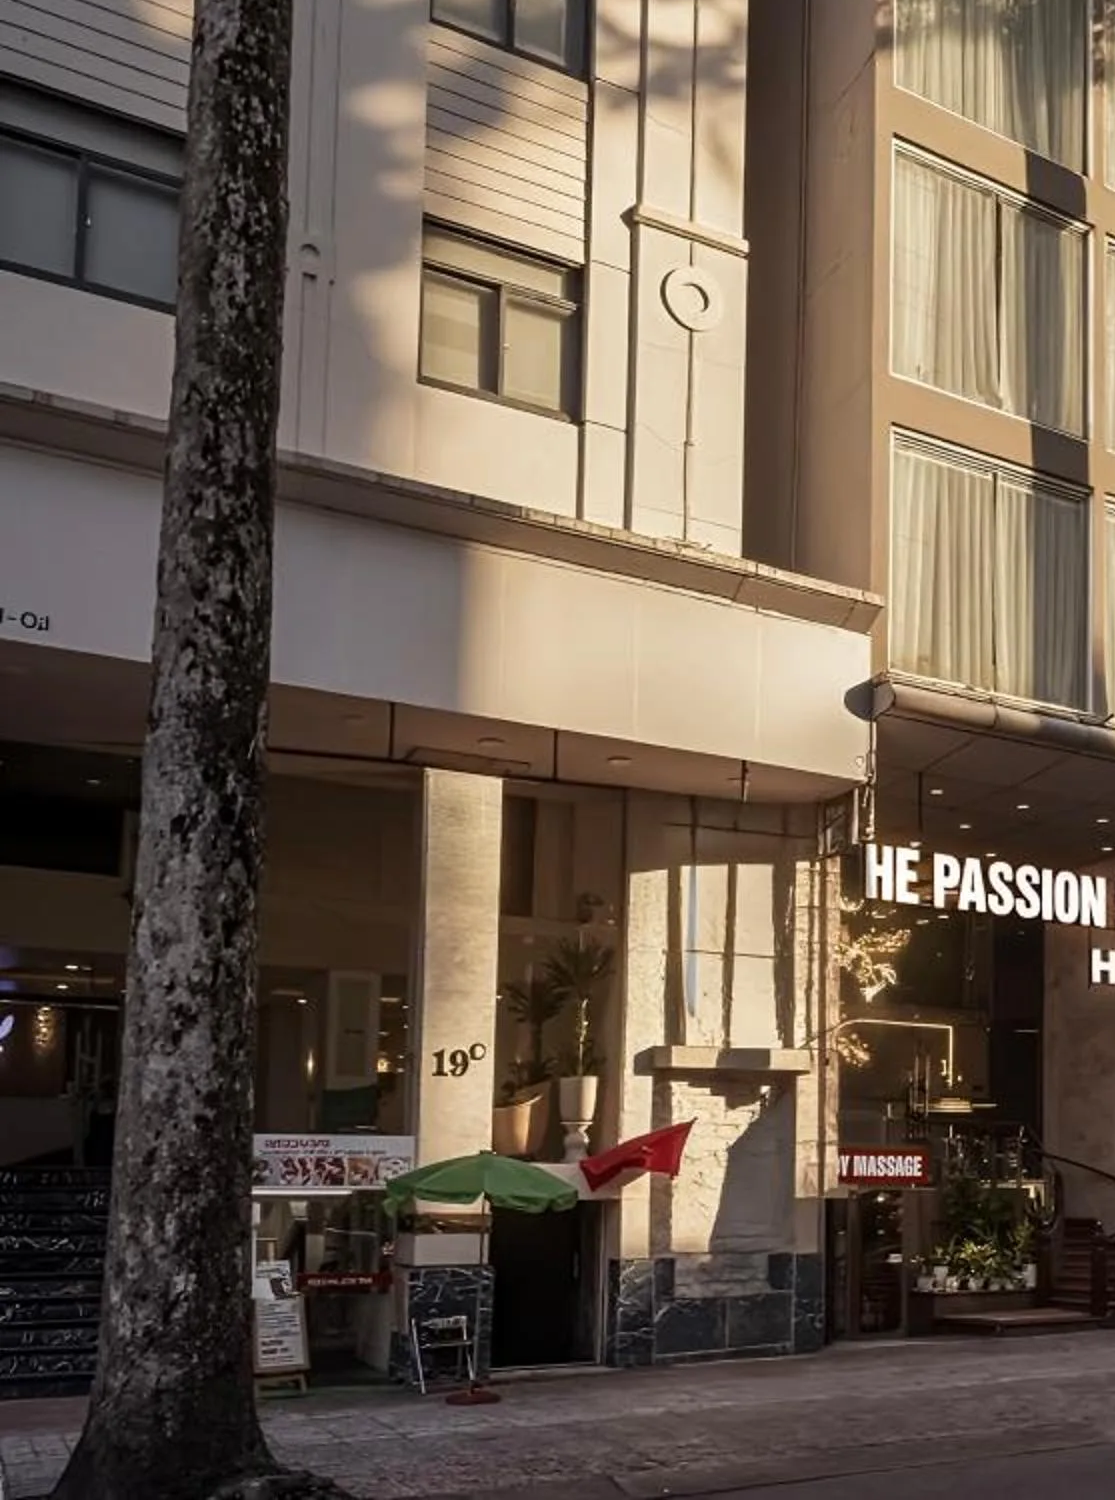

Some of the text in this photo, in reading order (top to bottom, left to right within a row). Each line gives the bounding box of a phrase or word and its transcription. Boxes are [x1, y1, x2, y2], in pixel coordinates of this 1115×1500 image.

[865, 843, 921, 905] HE
[932, 852, 1107, 928] PASSION
[853, 1155, 923, 1177] MASSAGE
